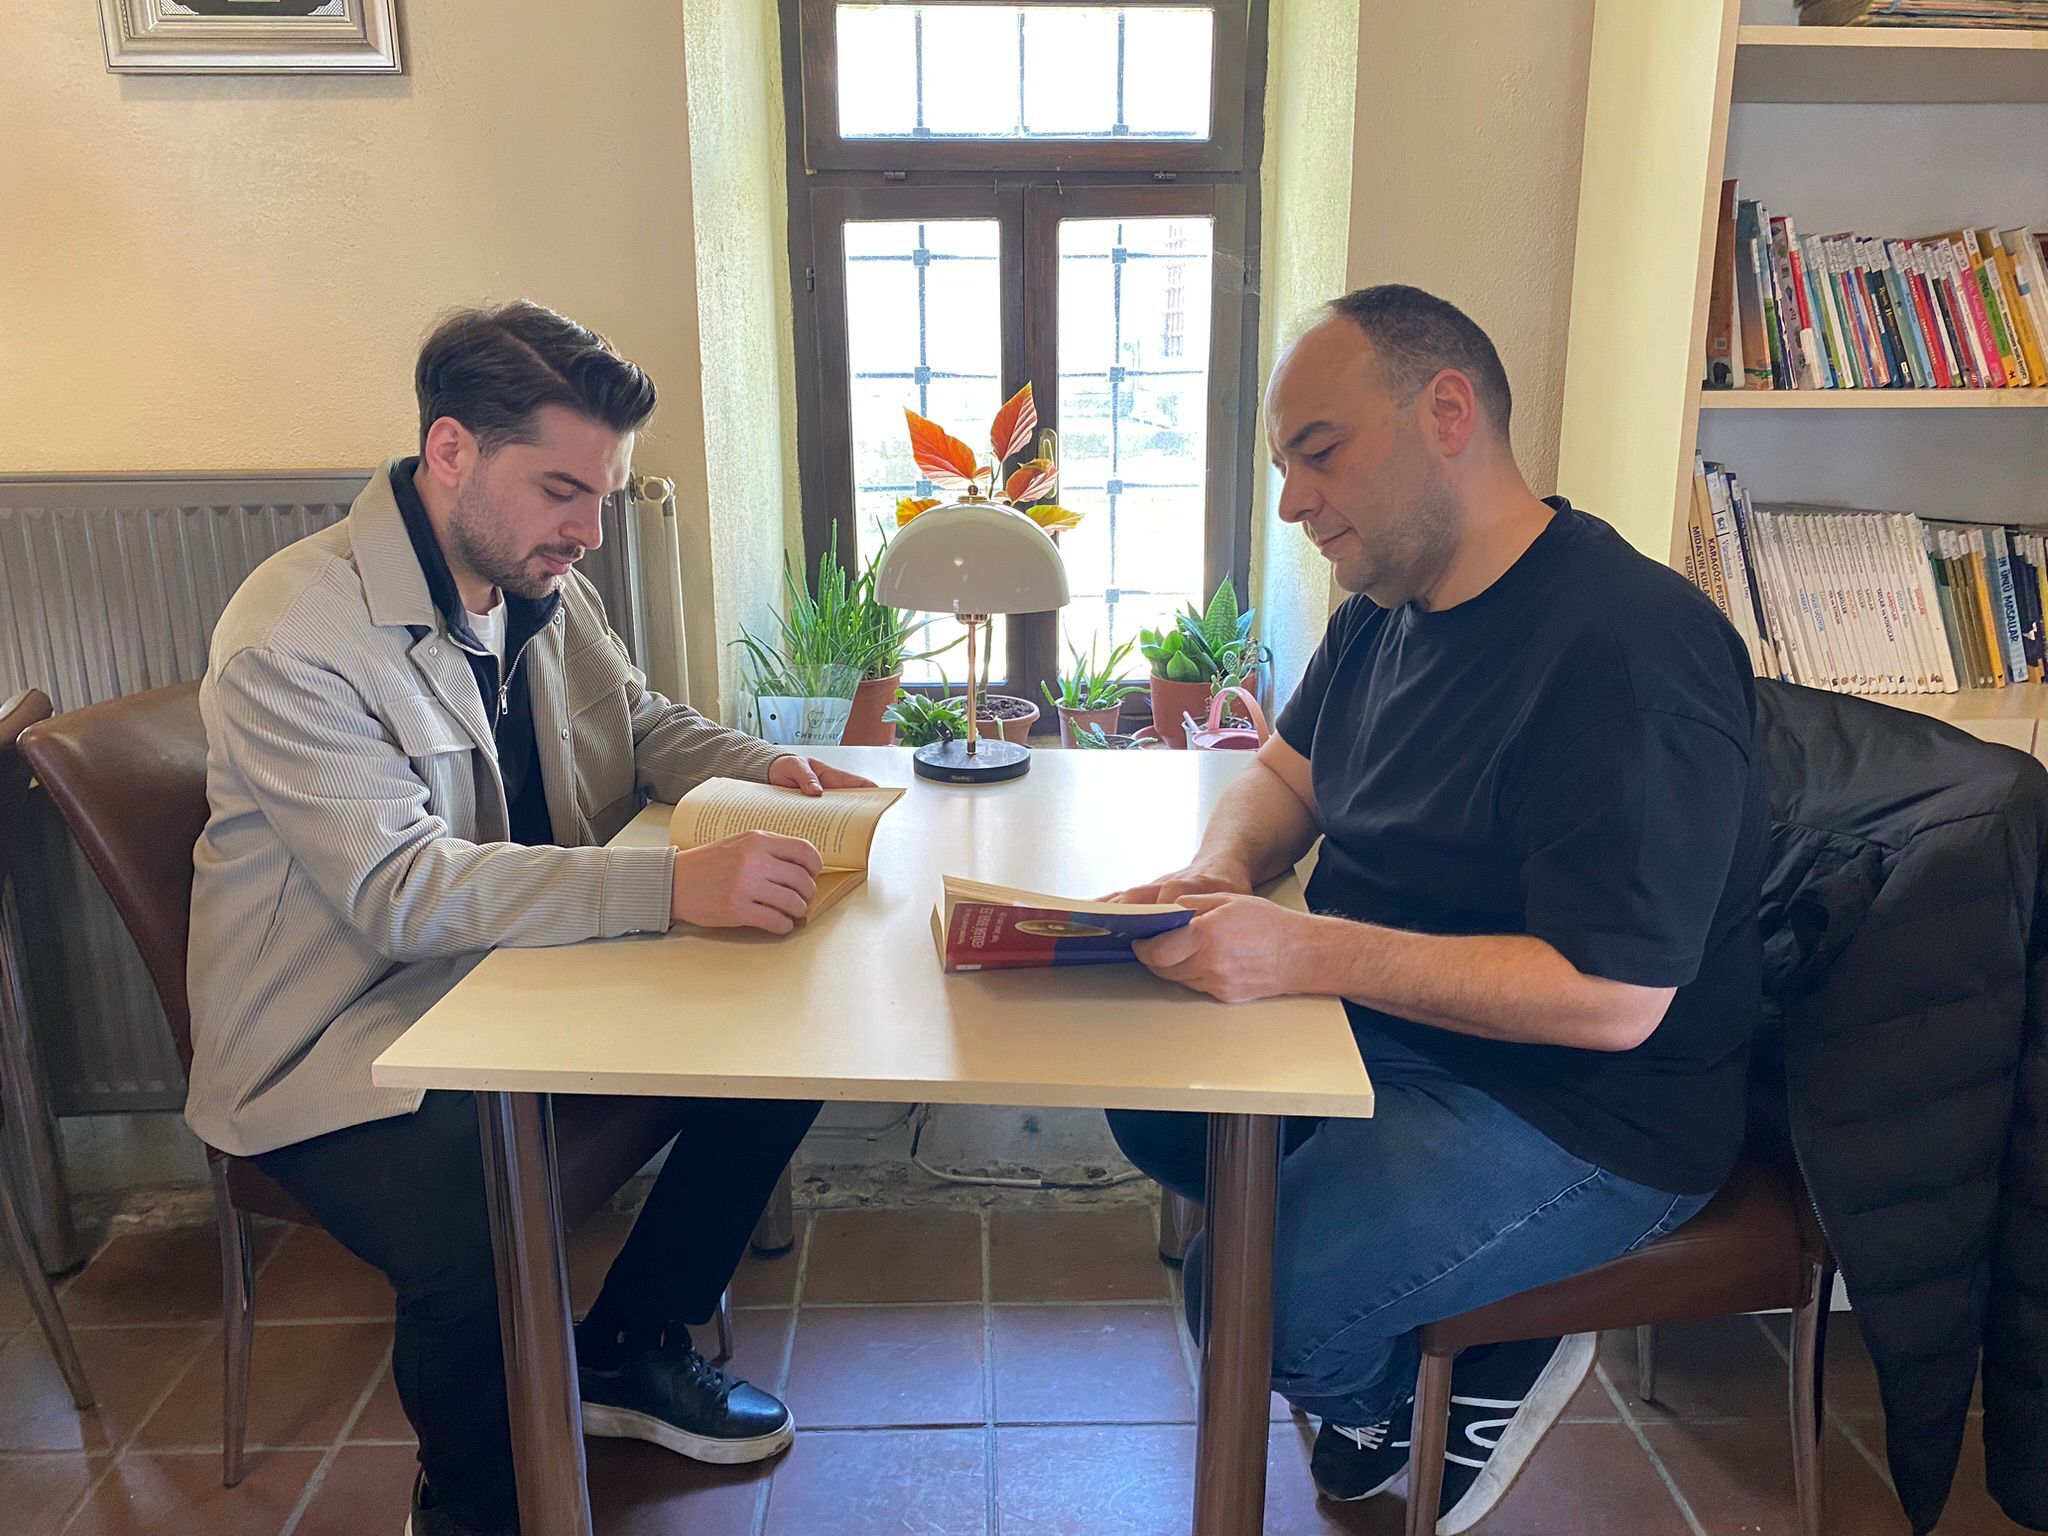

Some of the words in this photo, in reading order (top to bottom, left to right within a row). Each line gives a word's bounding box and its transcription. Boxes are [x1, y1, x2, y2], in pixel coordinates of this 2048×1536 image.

[1700, 571, 1711, 598] KULA
[1707, 538, 1722, 584] KARAGÖZ
[1715, 584, 1729, 620] PERDES
[1999, 569, 2015, 593] ÜNLÜ
[1876, 588, 1885, 608] TATLAR
[1883, 616, 1894, 642] KOKULAR
[2002, 595, 2020, 643] MASALLAR
